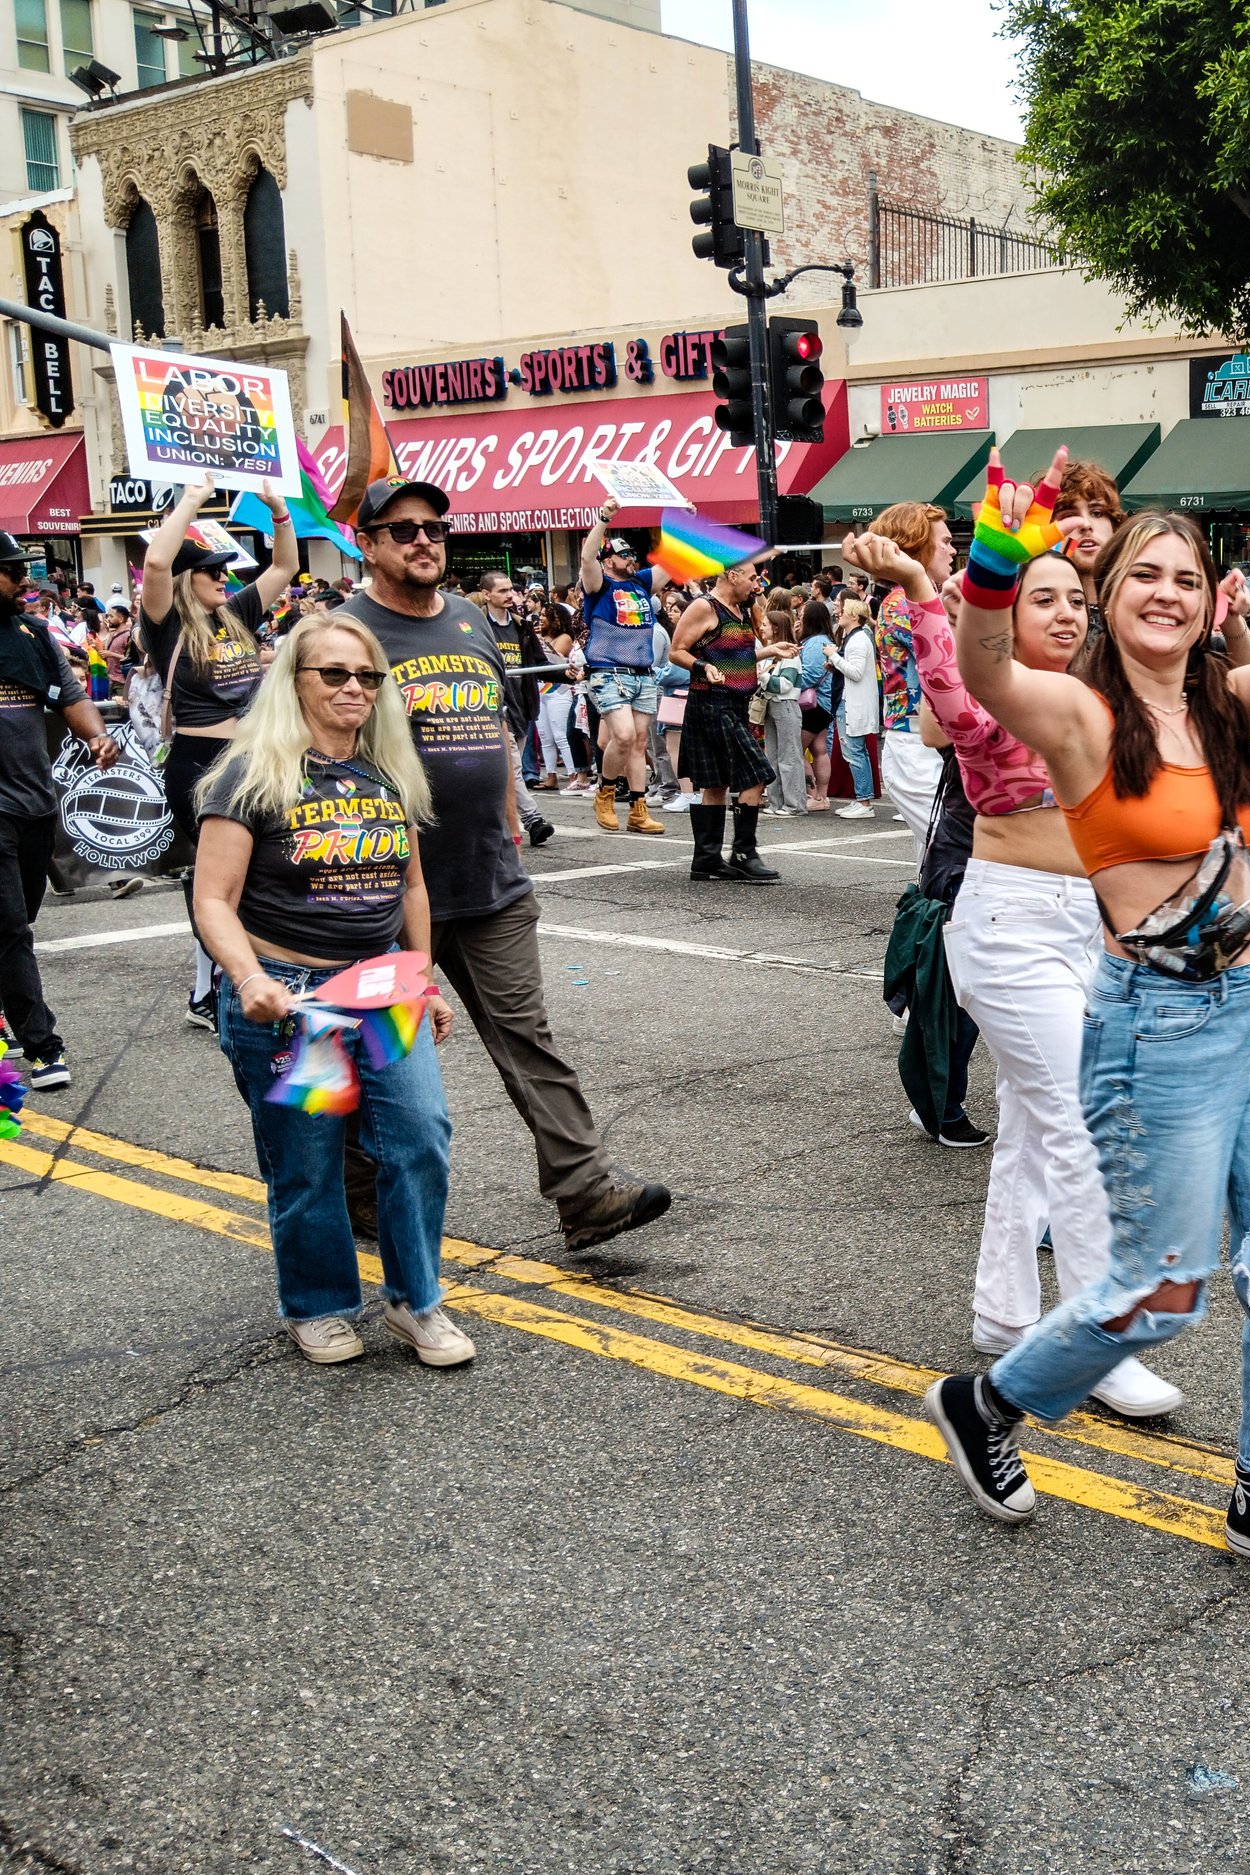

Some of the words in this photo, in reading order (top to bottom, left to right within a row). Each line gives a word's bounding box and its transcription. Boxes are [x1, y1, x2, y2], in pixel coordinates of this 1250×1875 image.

[36, 257, 55, 318] TAC
[44, 343, 63, 413] BELL
[382, 359, 498, 406] SOUVENIRS
[520, 344, 607, 392] SPORTS
[625, 340, 643, 380] &
[660, 331, 728, 378] GIFT
[138, 361, 267, 401] LABOR
[888, 385, 937, 404] JEWELRY
[940, 382, 979, 400] MAGIC
[145, 392, 273, 427] DIVERSITY
[922, 403, 953, 414] WATCH
[1220, 408, 1236, 417] 323
[145, 410, 273, 440] EQUALITY
[914, 415, 963, 428] BATTERIES
[148, 428, 276, 457] INCLUSION
[493, 422, 648, 489] SPORT
[634, 419, 672, 465] &
[157, 447, 225, 466] UNION:
[232, 457, 272, 472] YES!
[109, 481, 146, 504] TACO
[1180, 496, 1205, 507] 6731
[49, 508, 71, 517] BEST
[478, 512, 498, 532] AND
[852, 508, 873, 516] 6733
[401, 680, 499, 716] PRIDE
[452, 733, 468, 741] part
[83, 768, 142, 786] TEAMSTERS
[73, 828, 175, 868] HOLLYWOOD
[95, 832, 129, 845] LOCAL
[133, 828, 152, 842] 399
[291, 824, 410, 865] PRIDE
[345, 882, 362, 891] part
